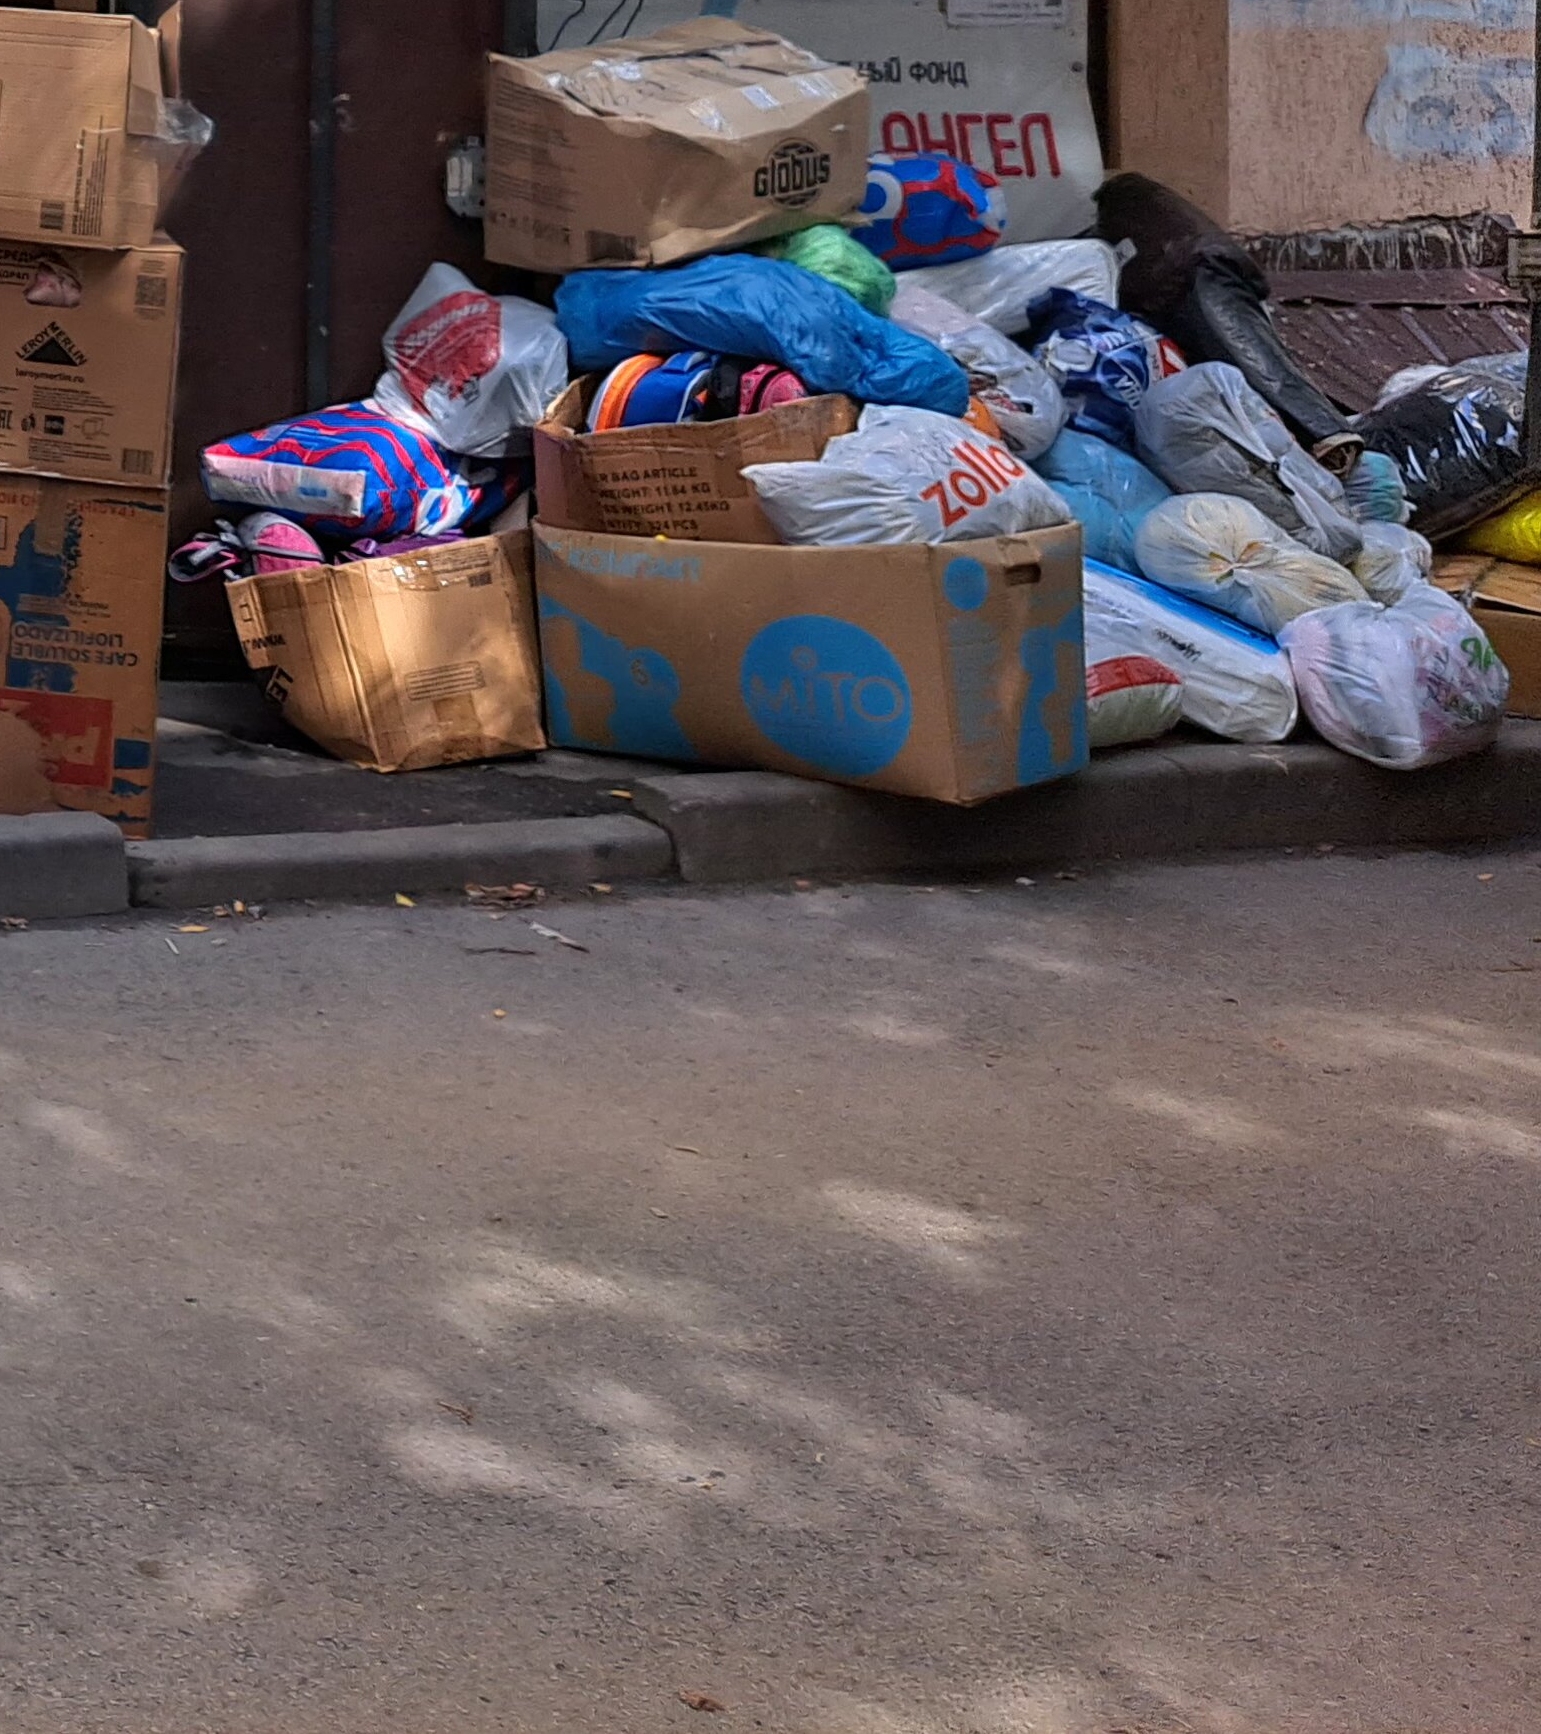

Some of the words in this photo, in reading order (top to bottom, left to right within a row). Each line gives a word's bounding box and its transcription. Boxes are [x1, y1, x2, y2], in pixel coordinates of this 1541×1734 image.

[908, 61, 969, 87] ФОНД
[880, 111, 1061, 178] АНГЕЛ
[15, 328, 50, 360] LEROY
[48, 321, 88, 366] MERLIN
[15, 367, 85, 383] leroymerlin.ru
[610, 469, 640, 482] BAG
[642, 466, 698, 479] ARTICLE
[14, 623, 123, 648] LIOFILIZADO
[12, 642, 91, 664] SOLUBLE
[95, 650, 138, 667] CAFE
